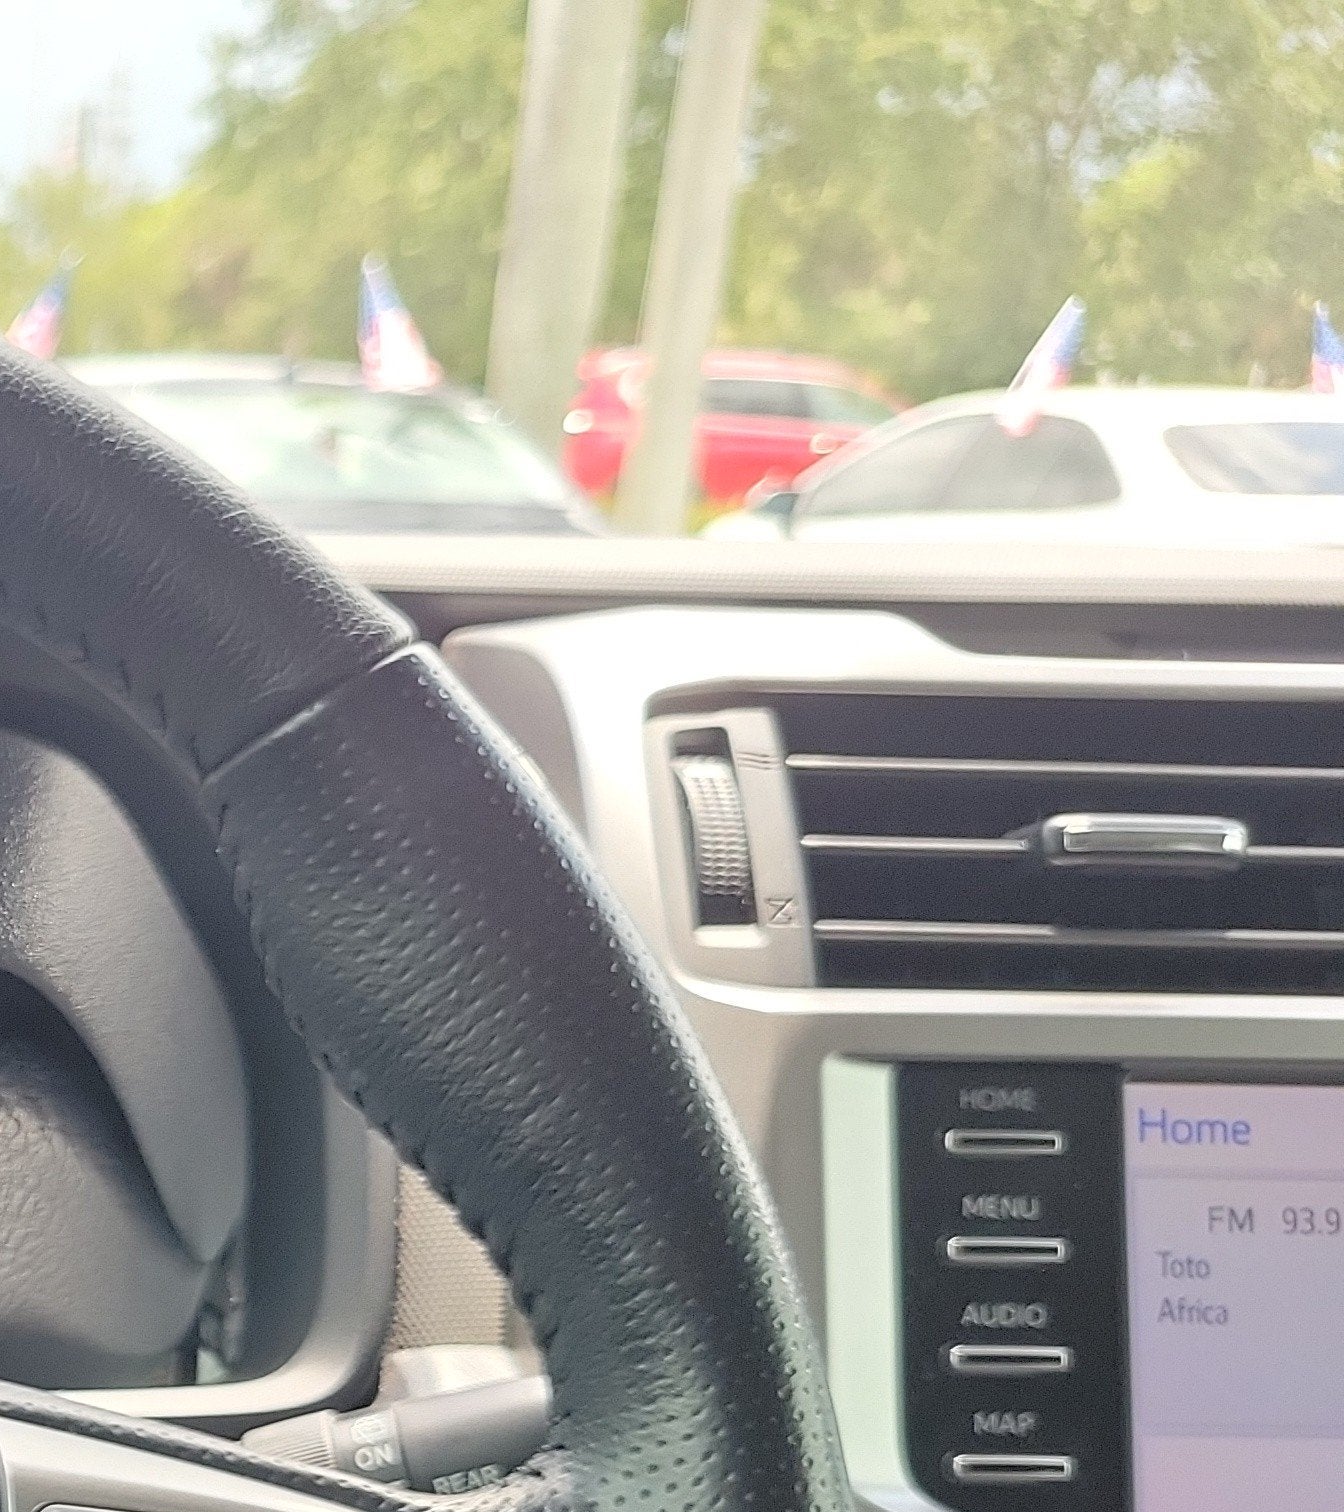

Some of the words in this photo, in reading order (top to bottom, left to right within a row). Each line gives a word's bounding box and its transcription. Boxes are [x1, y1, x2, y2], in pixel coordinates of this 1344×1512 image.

[959, 1087, 1037, 1112] HOME
[1137, 1107, 1251, 1146] Home
[962, 1194, 1041, 1221] MENU
[1208, 1205, 1255, 1233] FM
[1281, 1205, 1341, 1235] 93.9
[1154, 1250, 1211, 1279] Toto
[960, 1302, 1047, 1328] AUDIO
[1156, 1297, 1229, 1325] Africa
[973, 1410, 1035, 1437] MAP
[354, 1445, 395, 1471] ON
[432, 1463, 505, 1494] REAR
